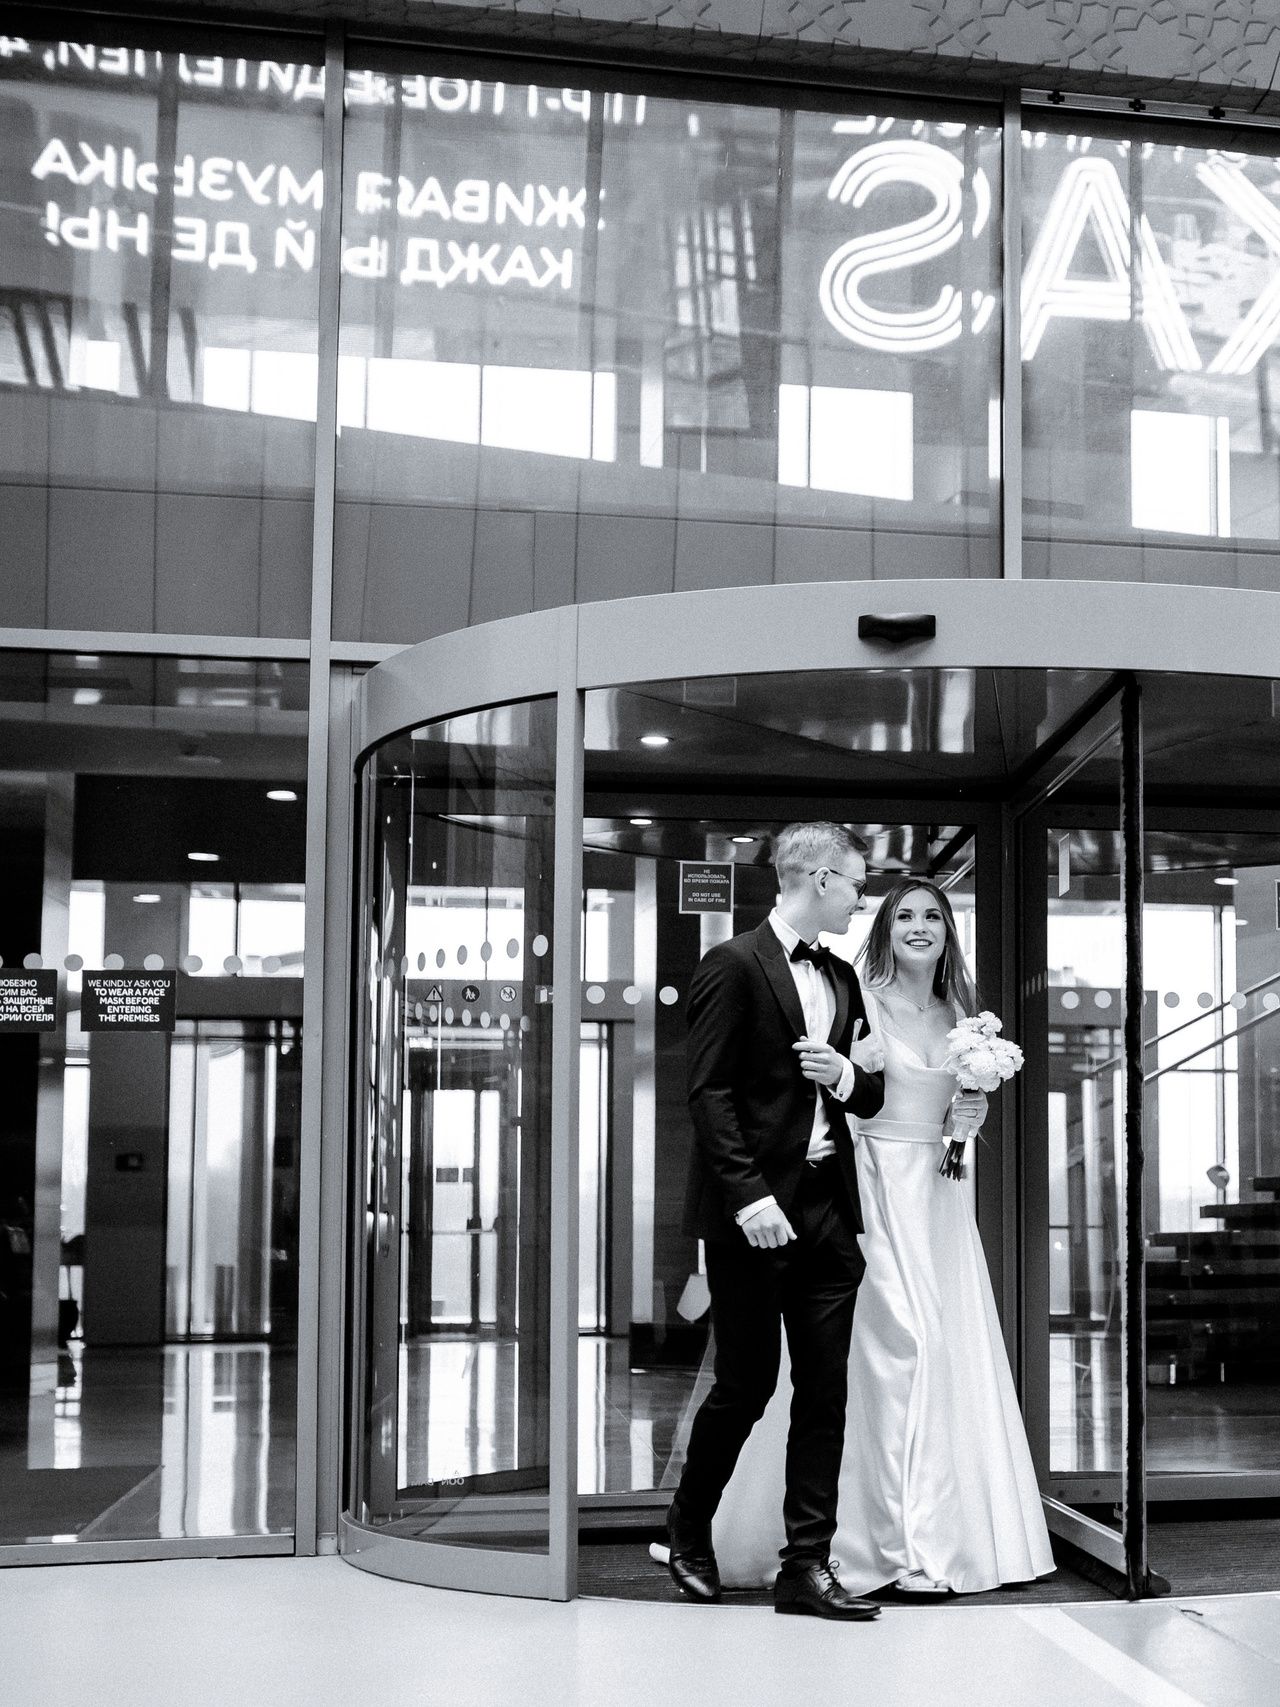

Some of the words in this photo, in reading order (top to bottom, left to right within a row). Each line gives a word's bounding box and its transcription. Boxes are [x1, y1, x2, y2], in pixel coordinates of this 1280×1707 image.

[88, 979, 101, 987] WE
[103, 979, 132, 987] KINDLY
[134, 979, 150, 987] ASK
[152, 979, 171, 987] YOU
[20, 988, 38, 996] ВАС
[94, 988, 107, 996] TO
[108, 988, 134, 996] WEAR
[135, 988, 141, 996] A
[143, 988, 165, 996] FACE
[3, 997, 53, 1005] ЗАЩИТНЫЕ
[100, 997, 124, 1005] MASK
[126, 997, 160, 1005] BEFORE
[6, 1005, 19, 1013] НА
[20, 1005, 45, 1013] ВСЕЙ
[107, 1006, 152, 1014] ENTERING
[24, 1013, 54, 1021] ОТЕЛЯ
[98, 1014, 117, 1022] THE
[118, 1014, 160, 1022] PREMISES
